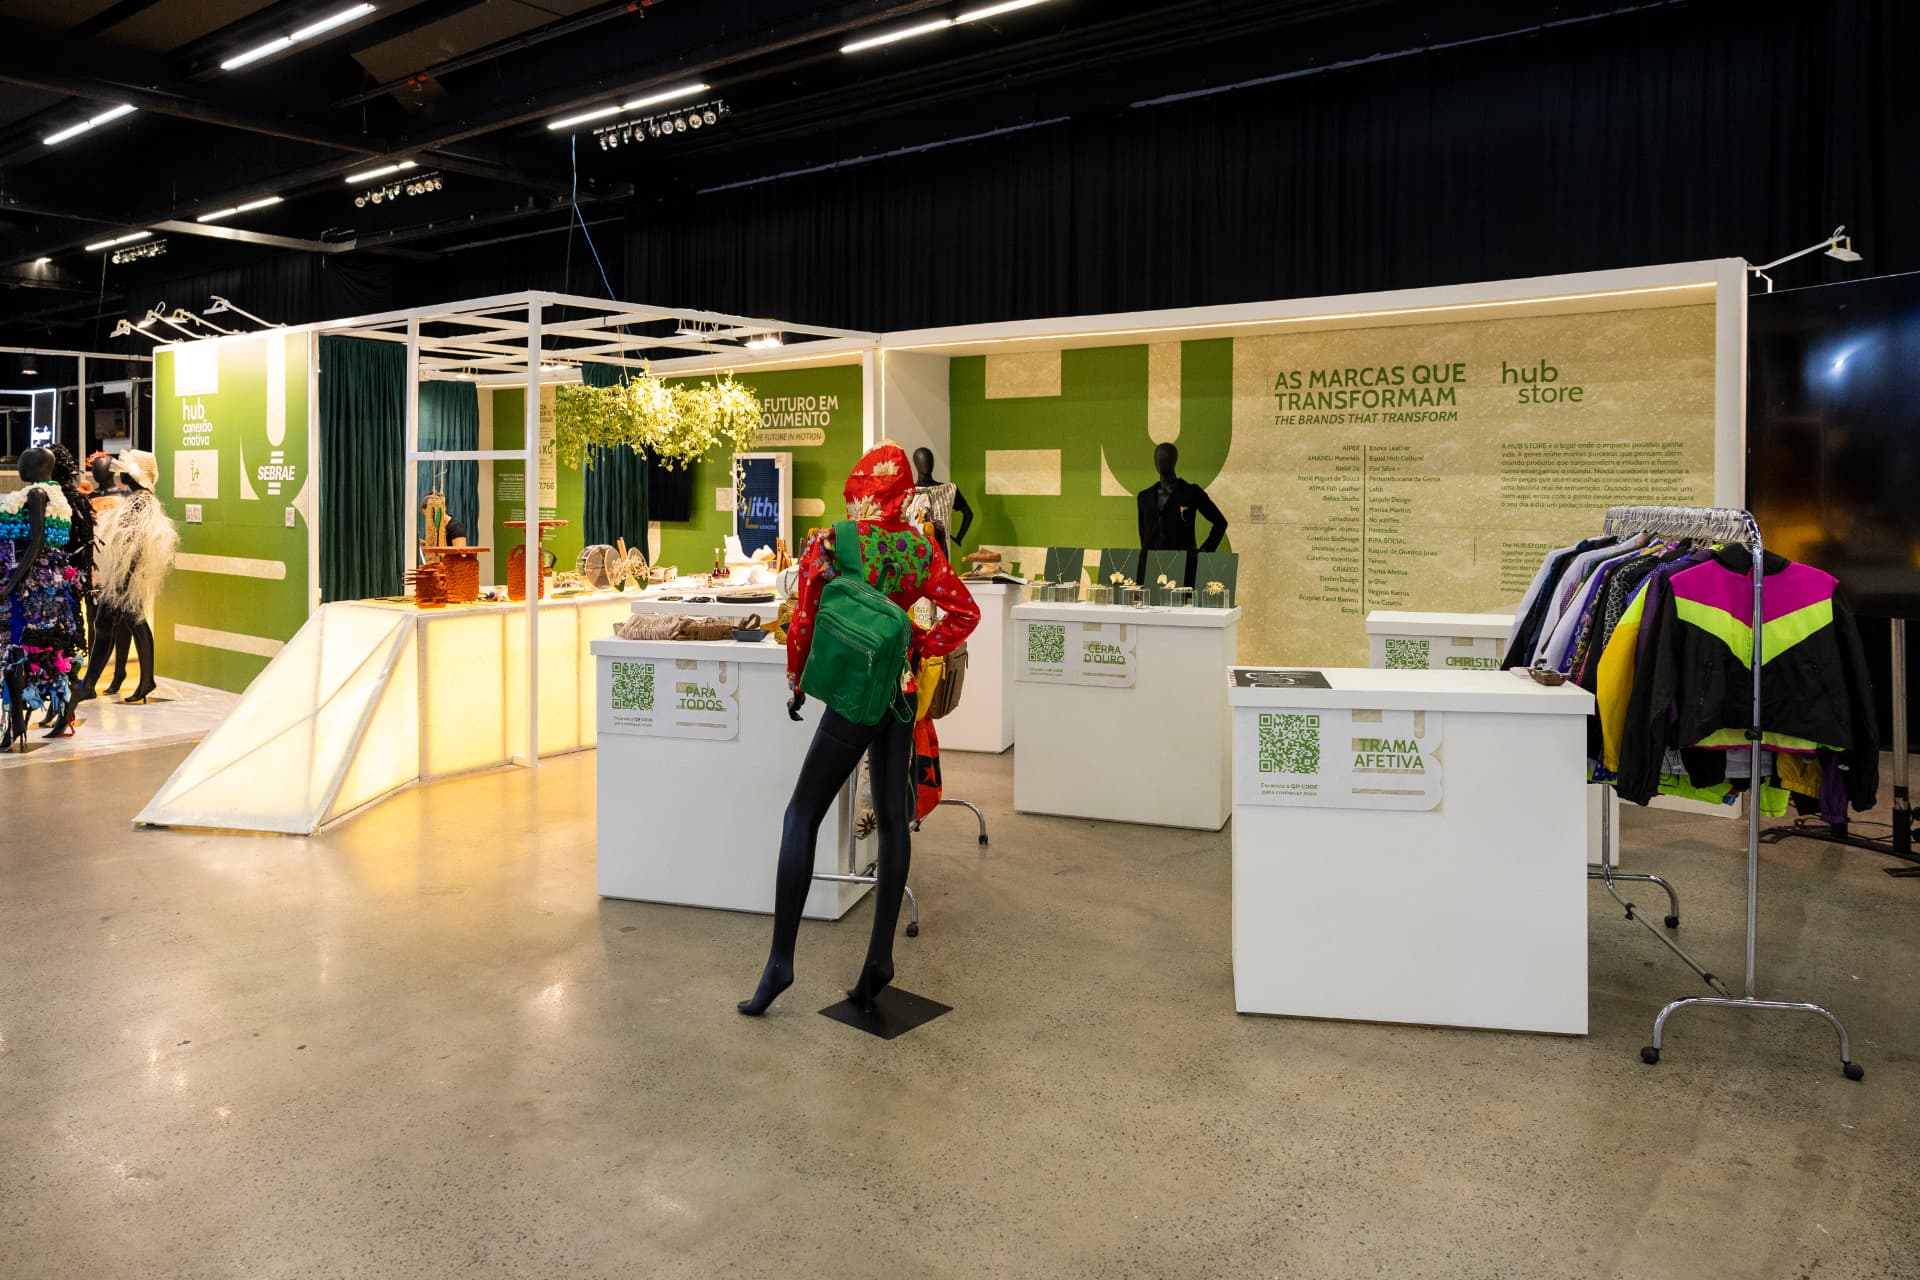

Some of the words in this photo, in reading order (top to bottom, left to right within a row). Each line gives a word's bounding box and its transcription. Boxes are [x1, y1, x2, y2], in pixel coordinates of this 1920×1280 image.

[1275, 371, 1301, 391] AS
[1309, 366, 1405, 389] MARCAS
[1412, 363, 1466, 384] QUE
[1502, 360, 1558, 385] hub
[1275, 387, 1456, 411] TRANSFORMAM
[1518, 385, 1584, 404] store
[182, 396, 206, 420] hub
[764, 396, 816, 412] FUTURO
[820, 394, 838, 410] EM
[1275, 415, 1297, 425] THE
[1298, 414, 1345, 425] BRANDS
[1348, 412, 1378, 424] THAT
[1382, 411, 1458, 424] TRANSFORM
[183, 418, 213, 434] conexão
[182, 434, 210, 447] criativa
[796, 432, 822, 440] MOTION
[258, 466, 296, 481] SEBRAE
[1088, 644, 1121, 654] CERRA
[1084, 654, 1126, 664] D'OURO
[686, 686, 716, 698] PARA
[680, 698, 724, 711] TODOS
[1360, 738, 1418, 753] TRAMA
[1354, 754, 1424, 769] AFETIVA
